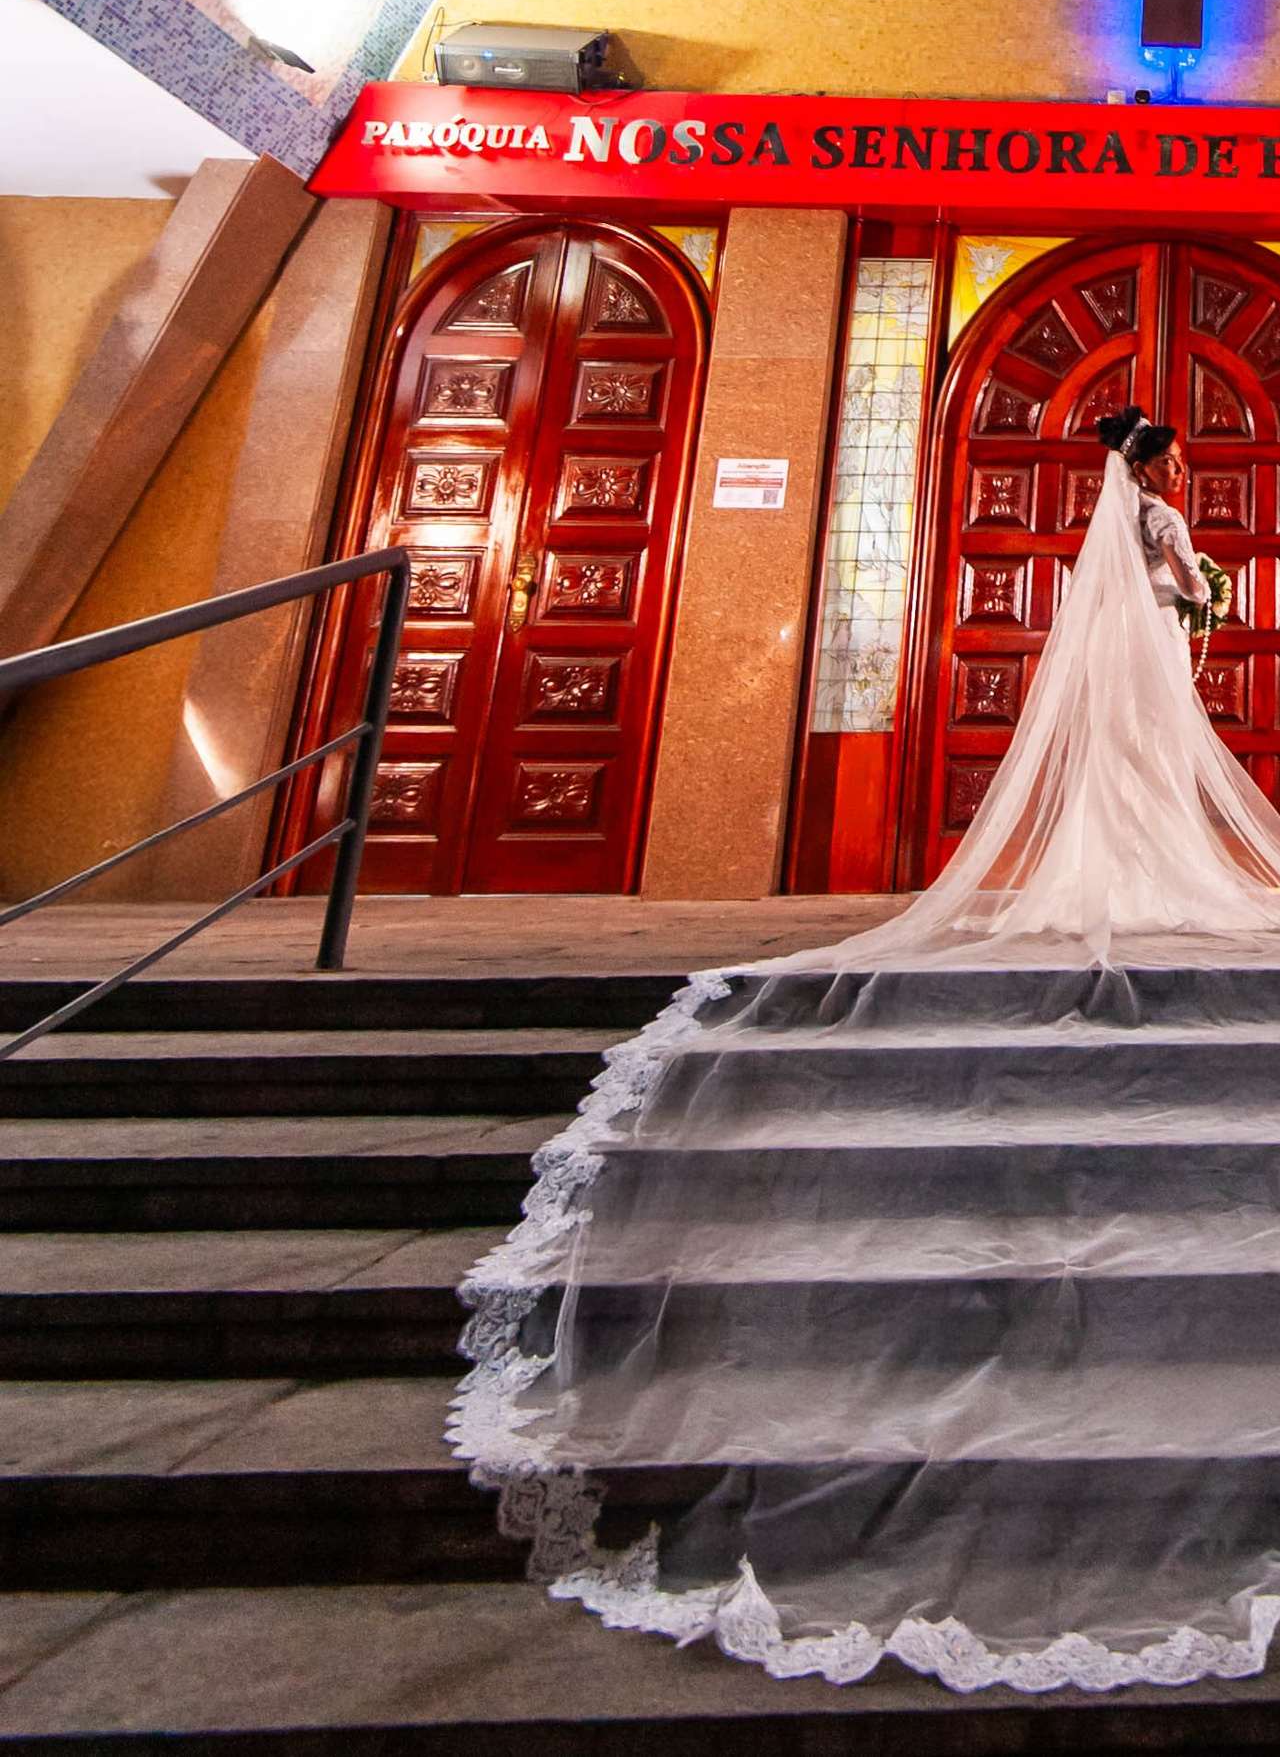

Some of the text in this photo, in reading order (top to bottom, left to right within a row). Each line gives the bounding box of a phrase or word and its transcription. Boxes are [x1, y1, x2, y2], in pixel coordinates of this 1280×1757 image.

[361, 114, 549, 151] PARÓQUIA
[563, 116, 792, 165] NOSSA
[810, 125, 1134, 174] SENHORA
[1154, 133, 1239, 178] DE
